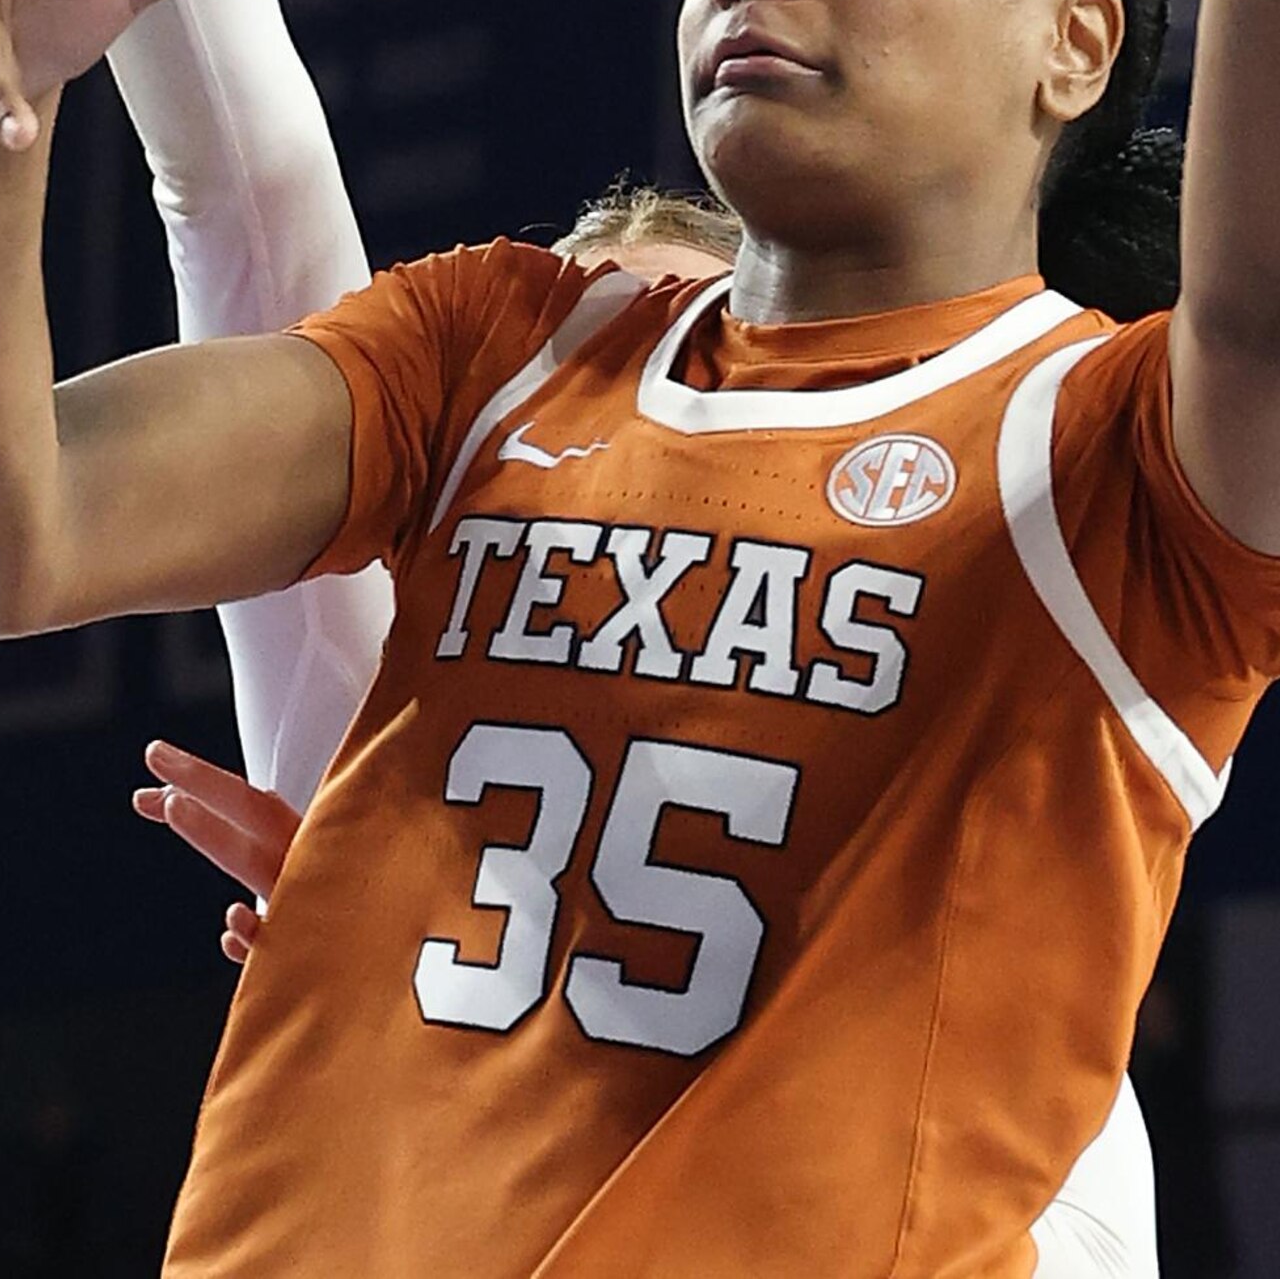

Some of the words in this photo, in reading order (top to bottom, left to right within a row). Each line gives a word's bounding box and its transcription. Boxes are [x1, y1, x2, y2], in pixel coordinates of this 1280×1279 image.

[836, 440, 946, 521] SEC
[433, 516, 925, 715] TEXAS
[412, 720, 801, 1057] 35
